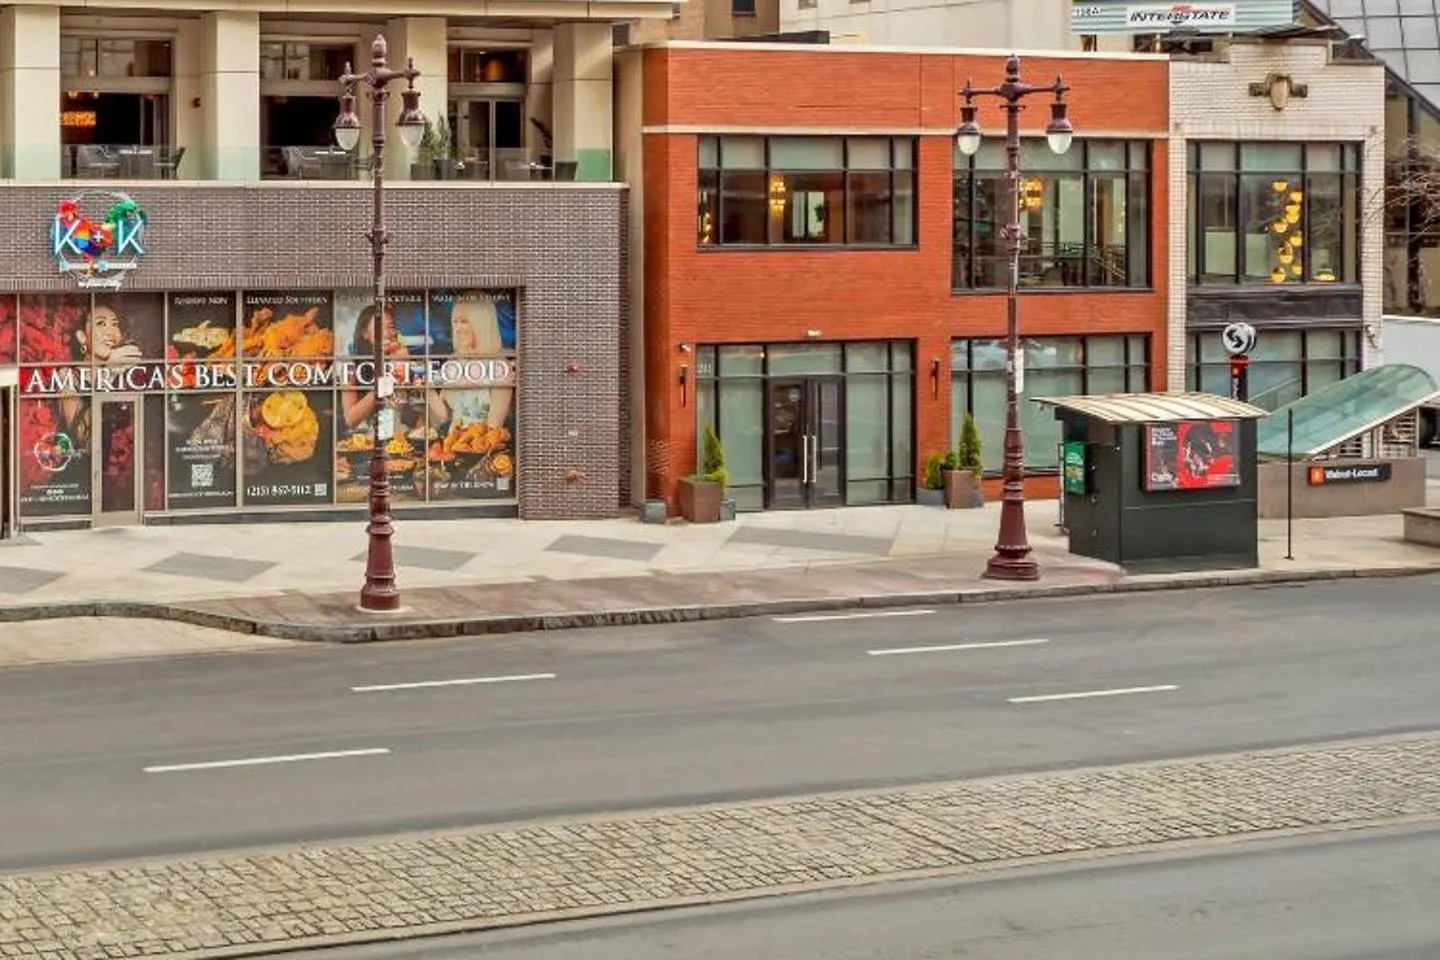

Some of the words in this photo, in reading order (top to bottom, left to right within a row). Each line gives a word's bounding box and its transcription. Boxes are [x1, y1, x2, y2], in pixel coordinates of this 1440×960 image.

[1130, 8, 1231, 23] INTERSTATE
[27, 365, 183, 393] AMERICA'S
[194, 362, 257, 390] BEST
[427, 359, 510, 386] FOOD
